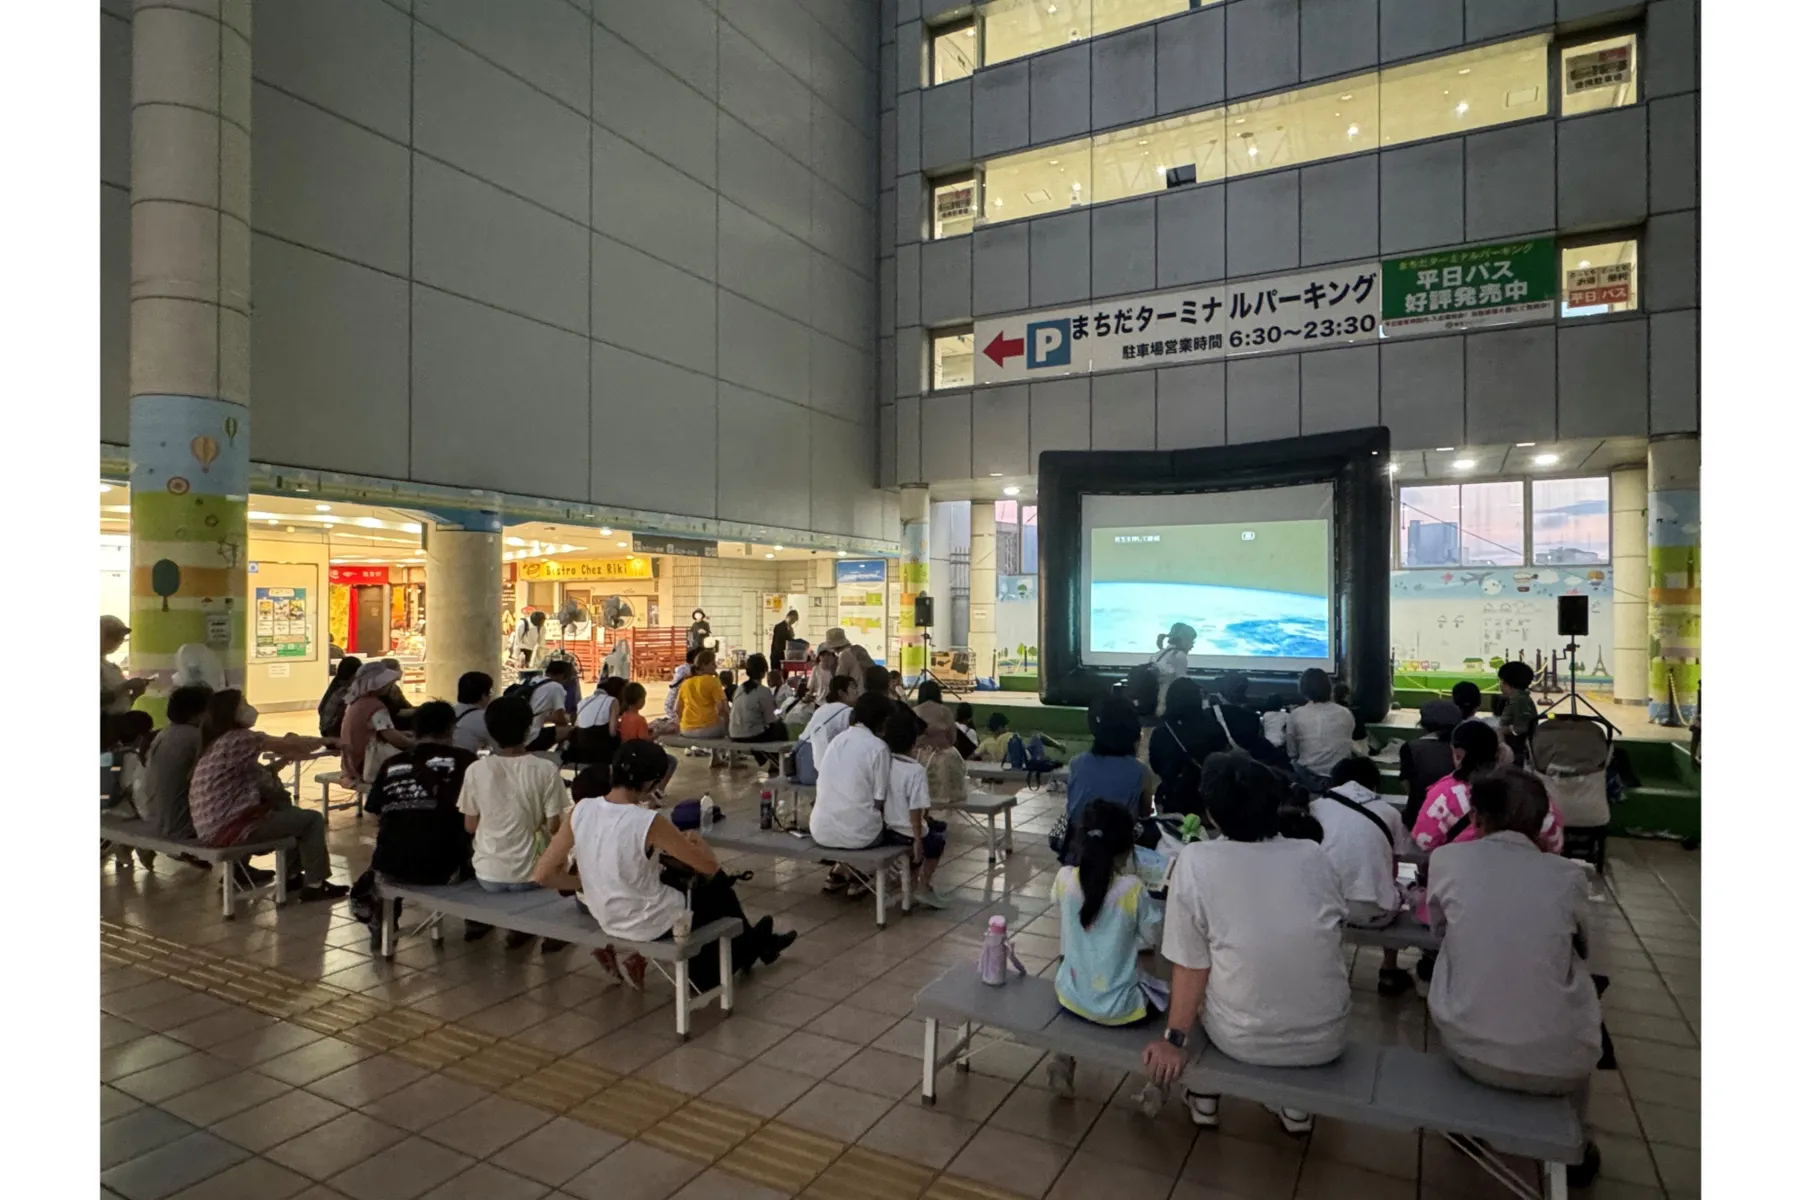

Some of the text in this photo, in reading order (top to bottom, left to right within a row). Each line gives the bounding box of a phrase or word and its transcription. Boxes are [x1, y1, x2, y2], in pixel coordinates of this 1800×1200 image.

[1417, 260, 1514, 290] 平日パス
[1072, 272, 1377, 341] まちだターミナルパーキング
[1405, 279, 1528, 313] 好評発売中
[1570, 291, 1596, 304] 平日
[1035, 327, 1063, 363] P
[1122, 333, 1223, 360] 駐車場営業時間
[546, 563, 628, 576] Bistro Chez Riki
